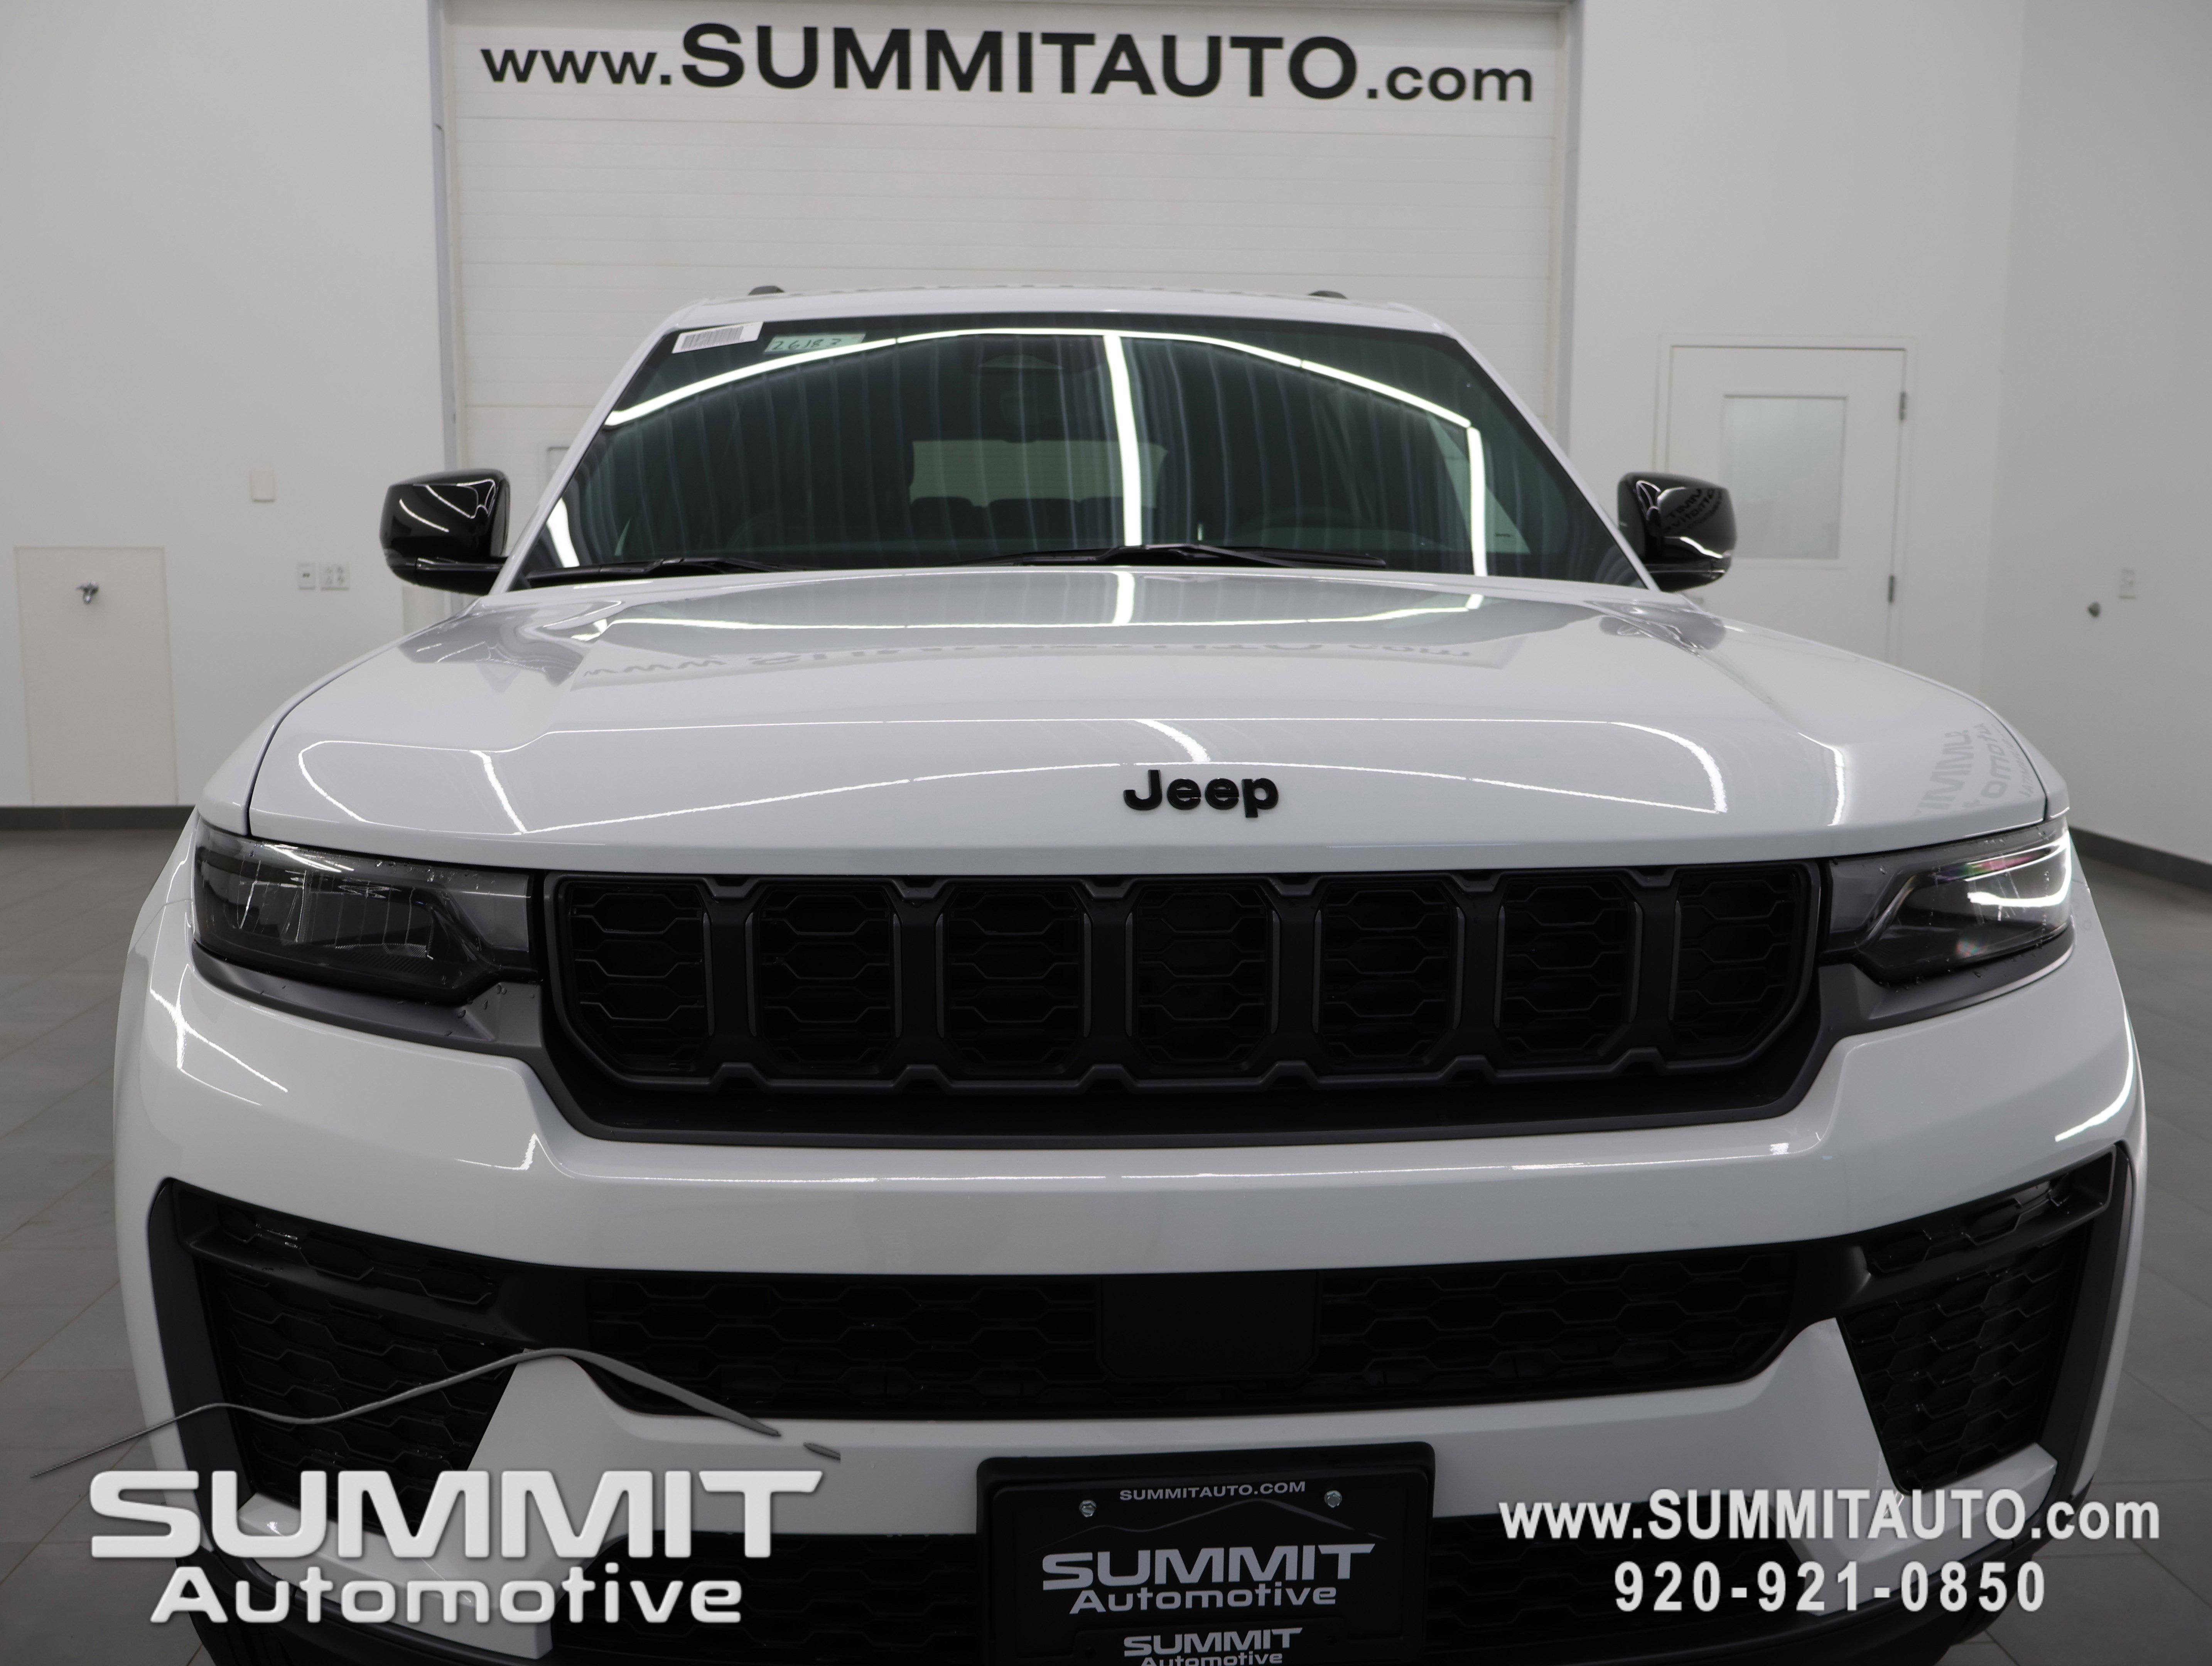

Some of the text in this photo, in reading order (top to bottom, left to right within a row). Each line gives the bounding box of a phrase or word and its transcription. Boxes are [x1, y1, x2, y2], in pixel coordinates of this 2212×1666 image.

[481, 21, 1534, 102] www.SUMMITAUTO.com
[1123, 769, 1279, 818] Jeep
[1119, 1481, 1306, 1501] SUMMITAUTO.COM
[1042, 1543, 1375, 1590] SUMMIT
[1069, 1581, 1336, 1614] Automotive
[1124, 1627, 1303, 1657] SUMMIT
